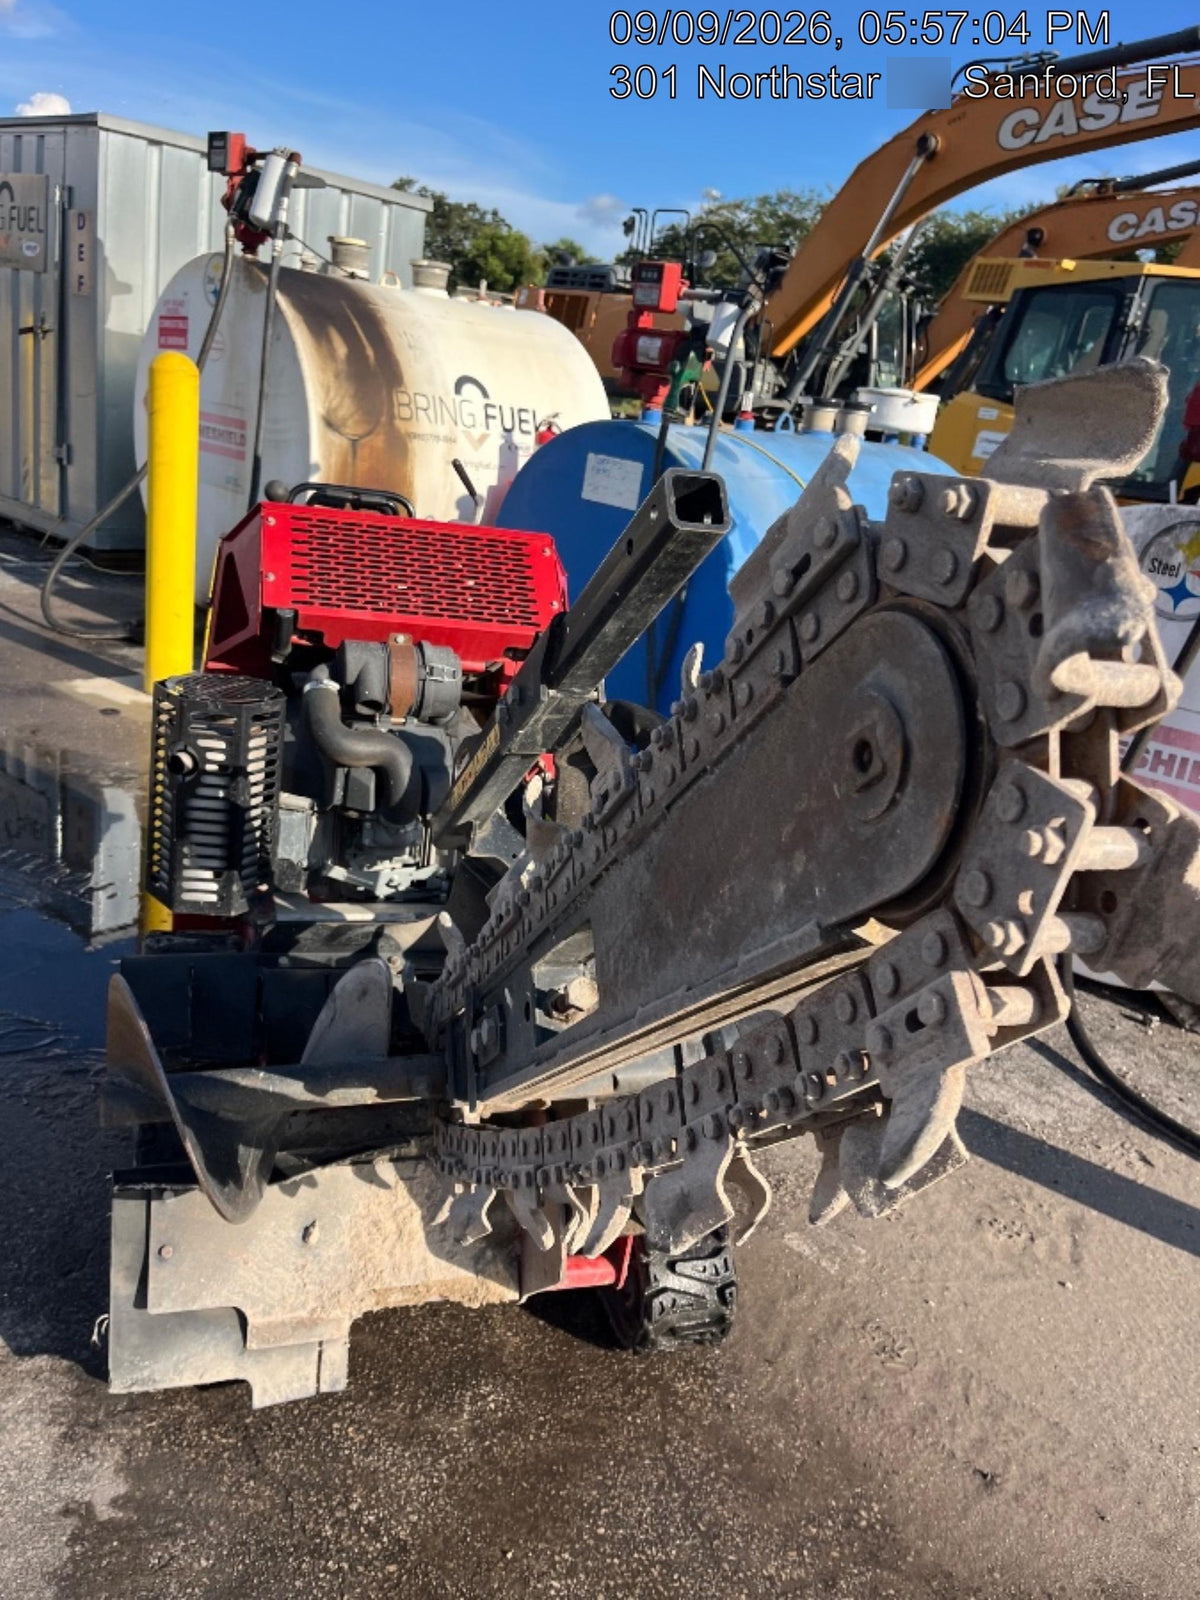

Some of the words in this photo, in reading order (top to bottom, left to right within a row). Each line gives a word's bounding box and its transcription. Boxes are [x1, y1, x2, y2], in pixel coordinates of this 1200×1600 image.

[997, 78, 1166, 150] CASE
[9, 205, 45, 234] FUEL
[1106, 199, 1200, 243] CAS
[395, 389, 476, 429] BRING
[1147, 557, 1182, 579] Steel
